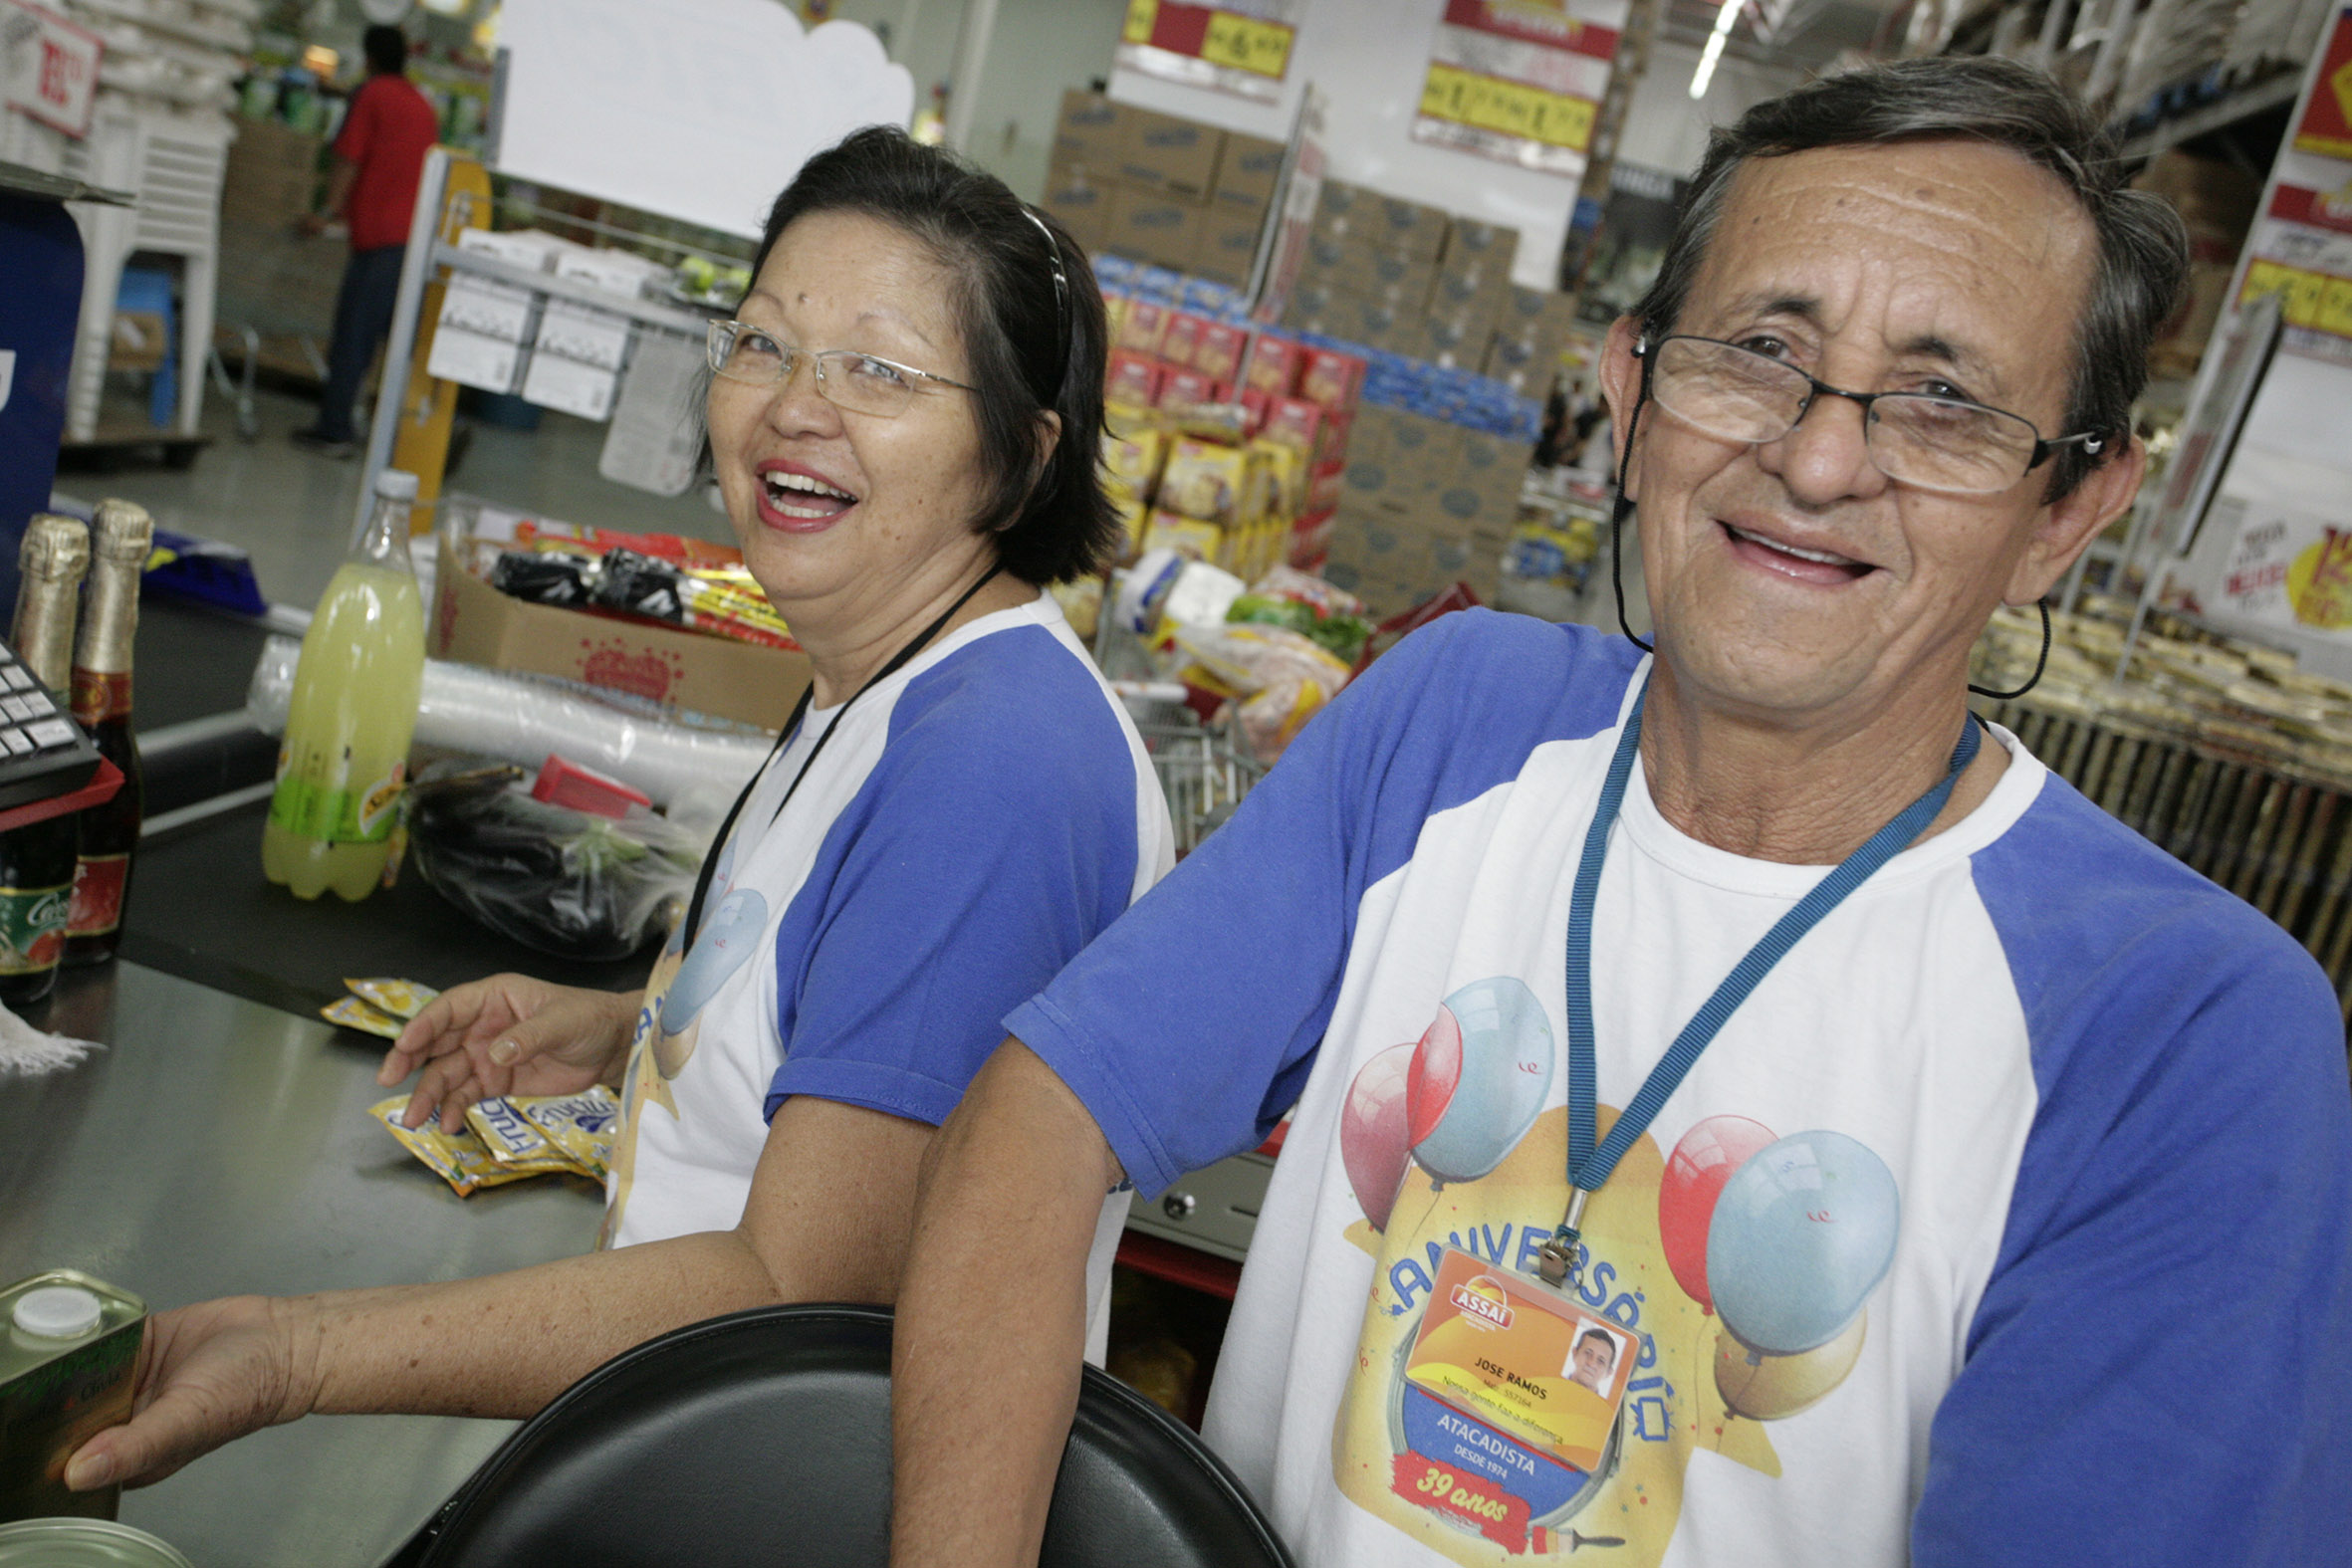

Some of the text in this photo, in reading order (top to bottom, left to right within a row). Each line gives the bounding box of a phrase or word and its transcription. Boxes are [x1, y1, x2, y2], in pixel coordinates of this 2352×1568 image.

[1475, 1357, 1547, 1400] JOSE RAMOS
[1437, 1414, 1535, 1476] ATACADISTA
[1454, 1444, 1509, 1480] DESDE 1974
[1416, 1467, 1509, 1522] 39 anos
